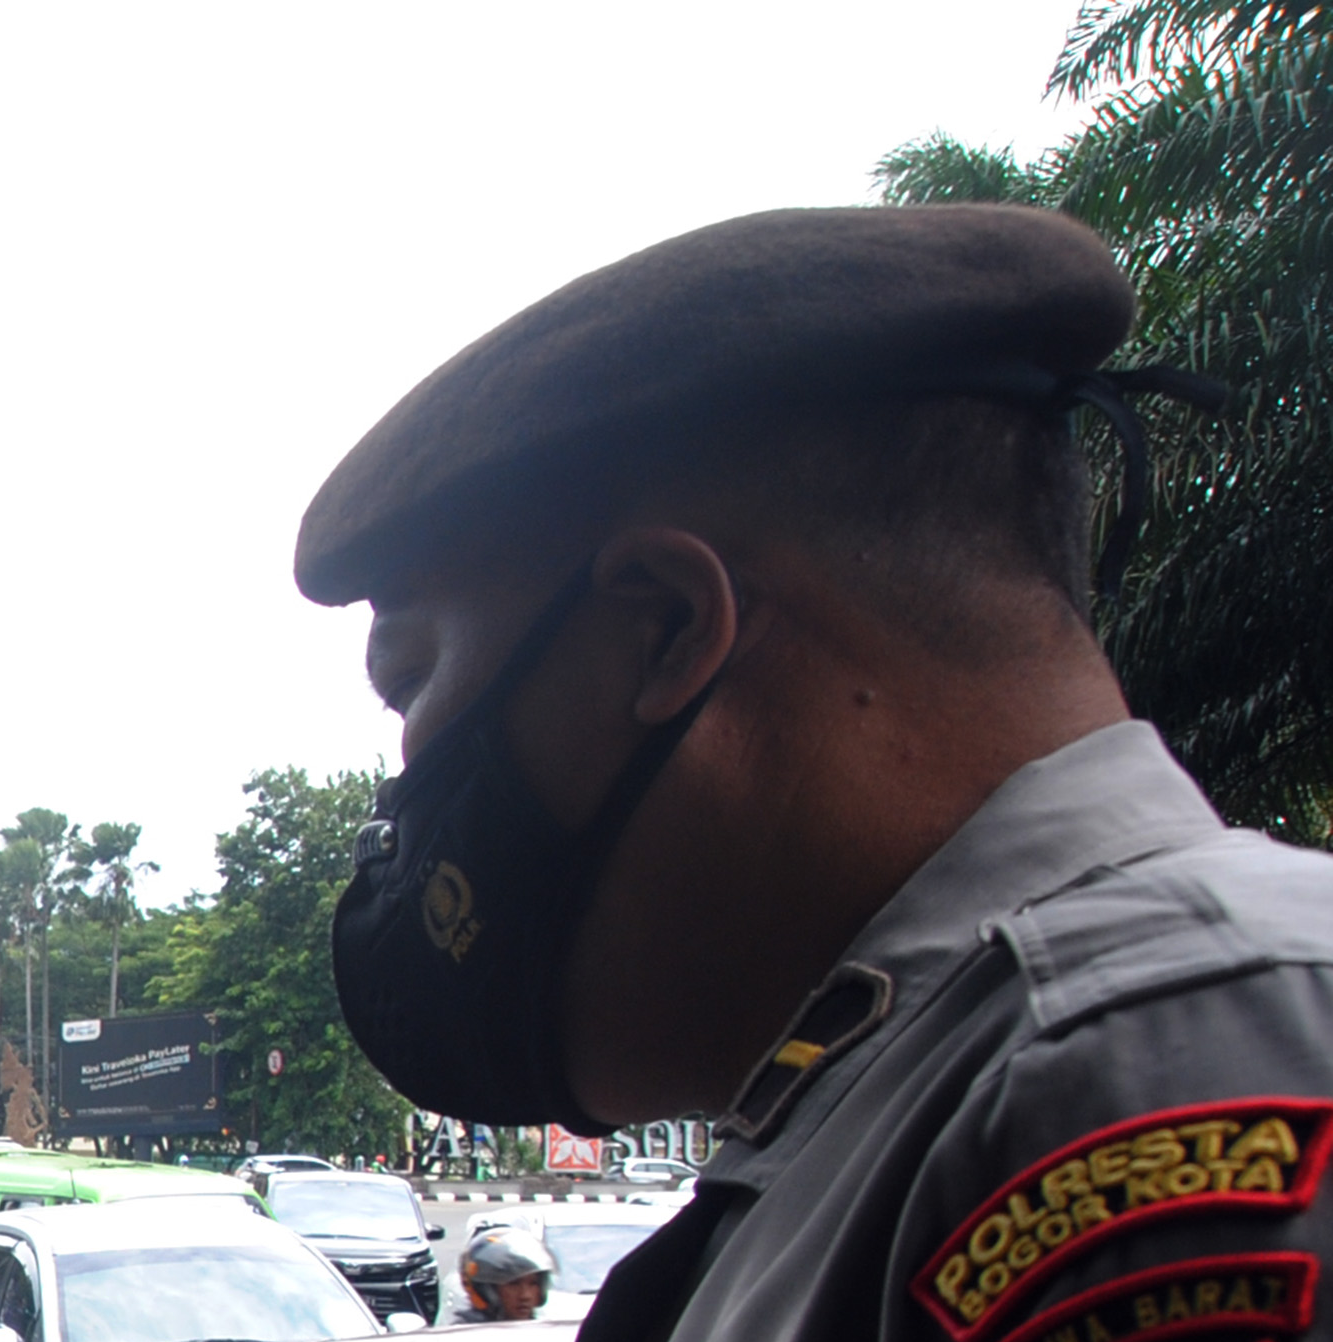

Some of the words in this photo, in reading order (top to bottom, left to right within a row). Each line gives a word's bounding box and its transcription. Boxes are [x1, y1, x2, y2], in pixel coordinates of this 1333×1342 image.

[81, 1064, 100, 1075] Kini
[101, 1054, 147, 1072] Traveloka
[148, 1045, 190, 1060] PayLater
[936, 1117, 1298, 1306] POLRESTA
[957, 1193, 1115, 1321] BOGOR
[1126, 1158, 1285, 1206] KOTA
[1134, 1277, 1285, 1330] BARAT
